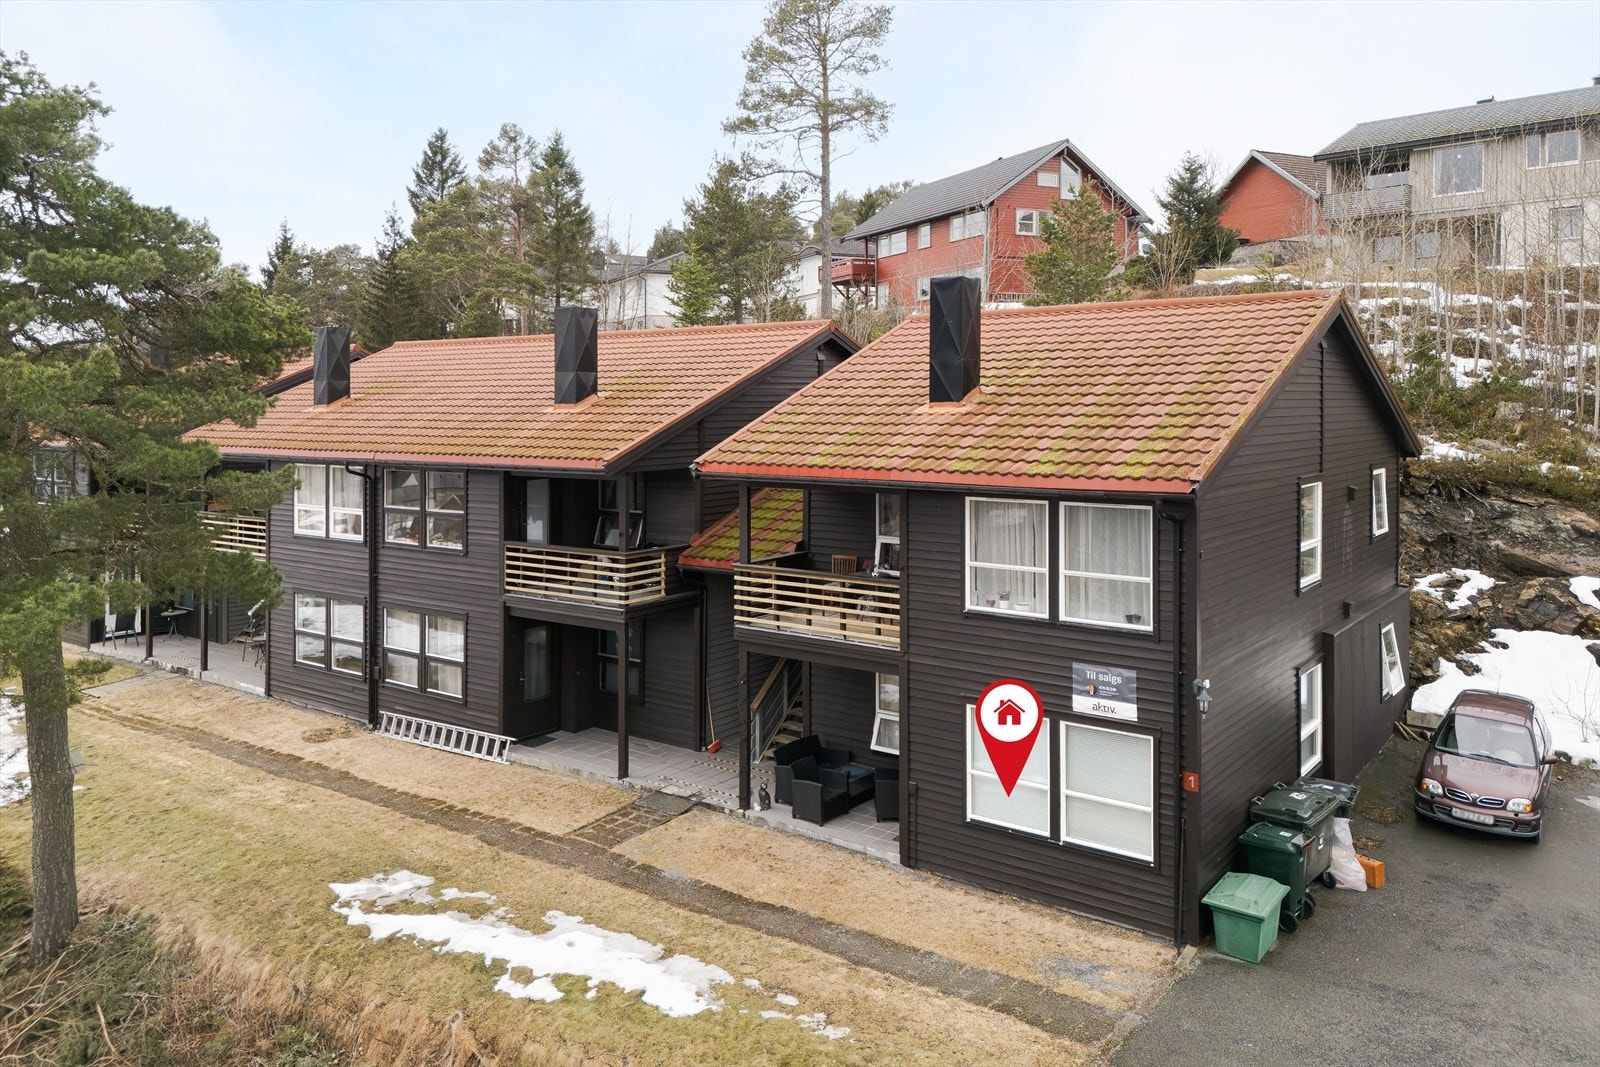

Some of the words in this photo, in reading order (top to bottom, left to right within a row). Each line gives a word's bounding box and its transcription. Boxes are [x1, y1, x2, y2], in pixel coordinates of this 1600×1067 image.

[1086, 670, 1096, 680] Til
[1098, 672, 1122, 685] salgs
[1188, 776, 1195, 788] 1
